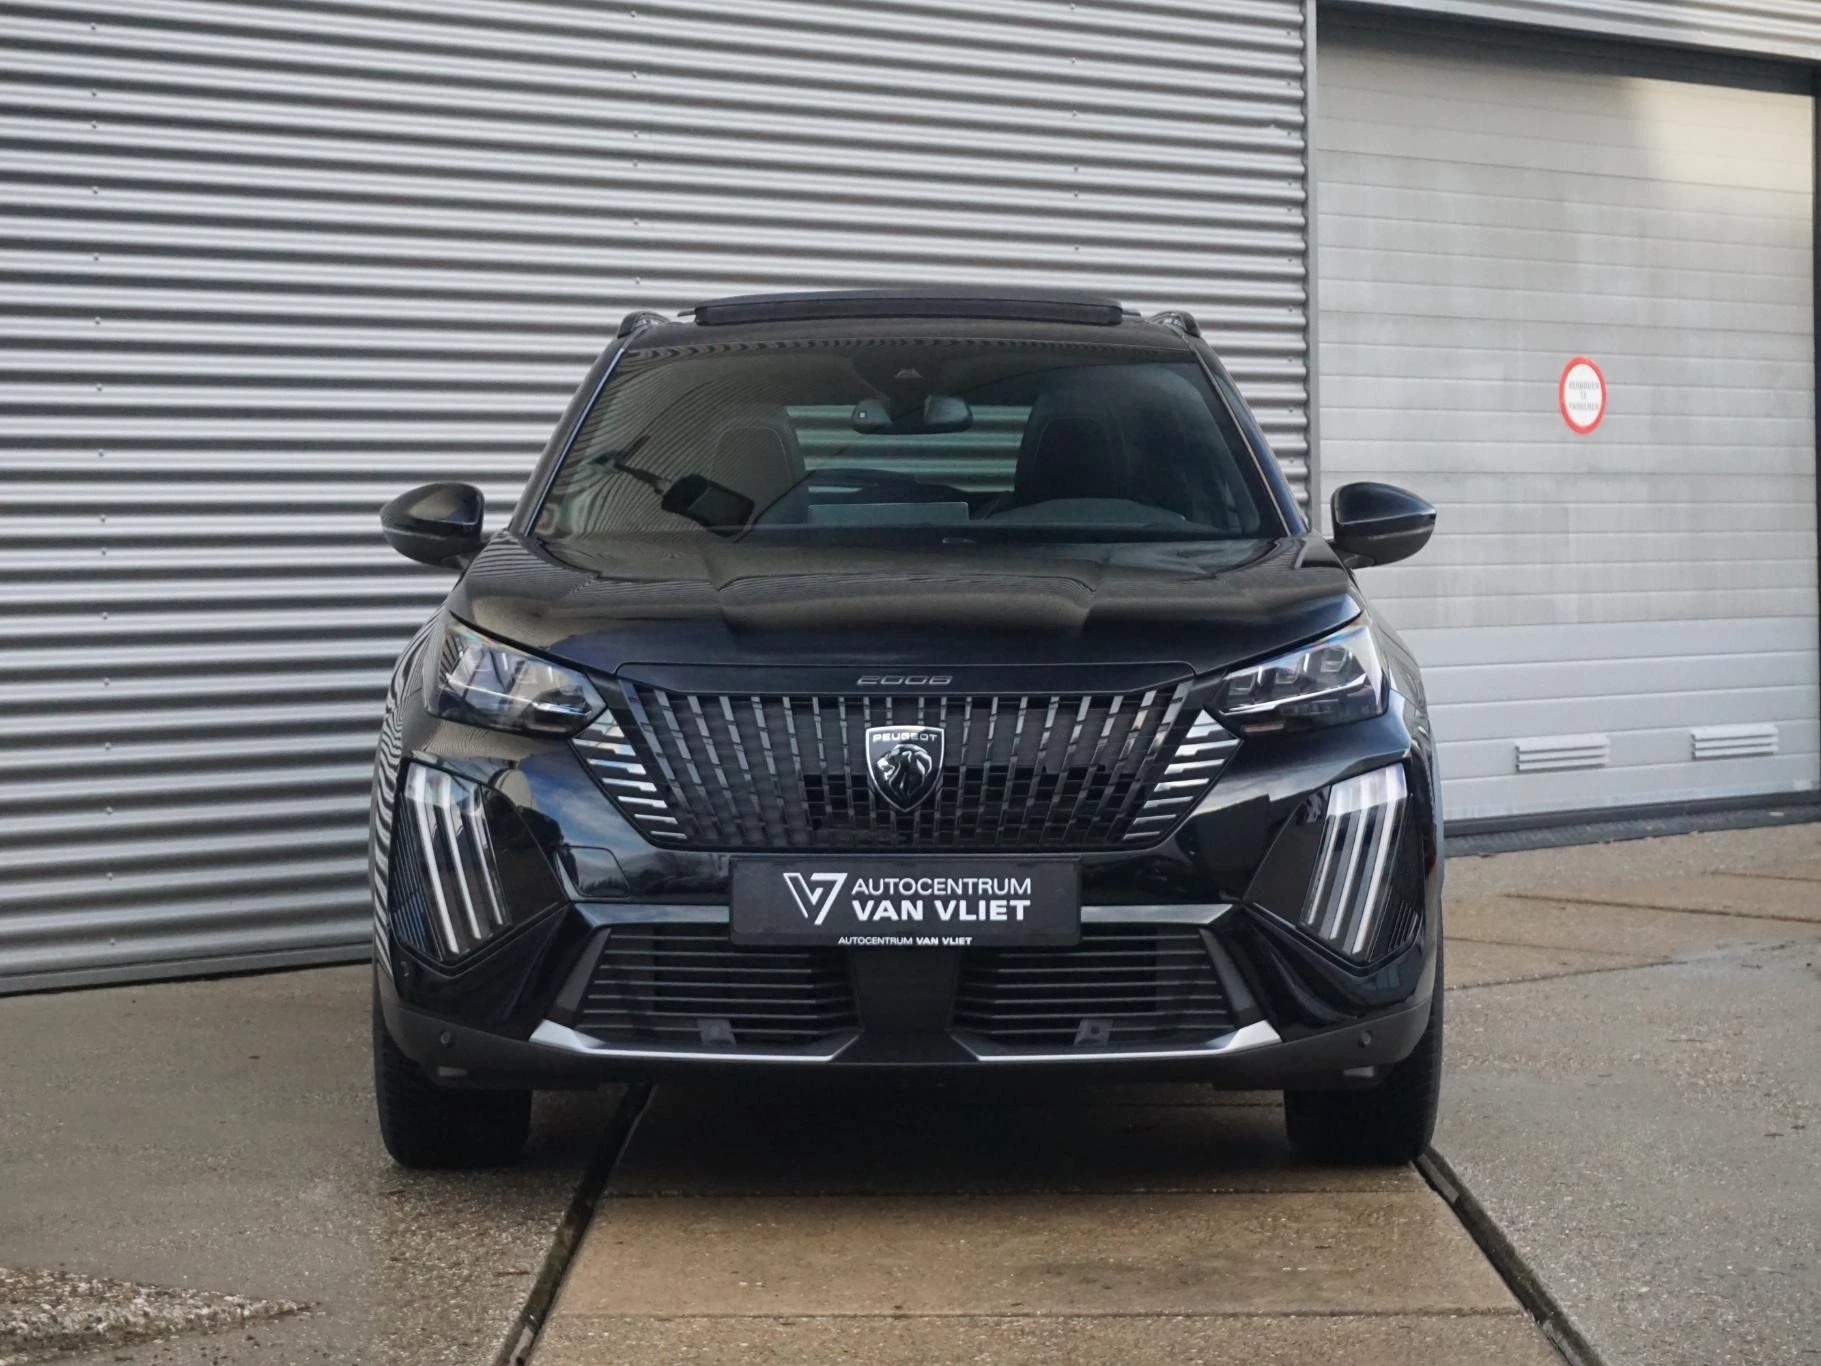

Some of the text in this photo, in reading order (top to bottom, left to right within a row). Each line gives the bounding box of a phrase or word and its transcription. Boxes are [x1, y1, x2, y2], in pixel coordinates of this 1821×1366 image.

[856, 675, 953, 685] 2008
[872, 732, 938, 743] PEUGEOT
[851, 877, 1032, 896] AUTOCENTRUM
[851, 899, 1032, 922] VAN VLIET
[837, 936, 973, 946] AUTOCENTRUM VAN VLIET
